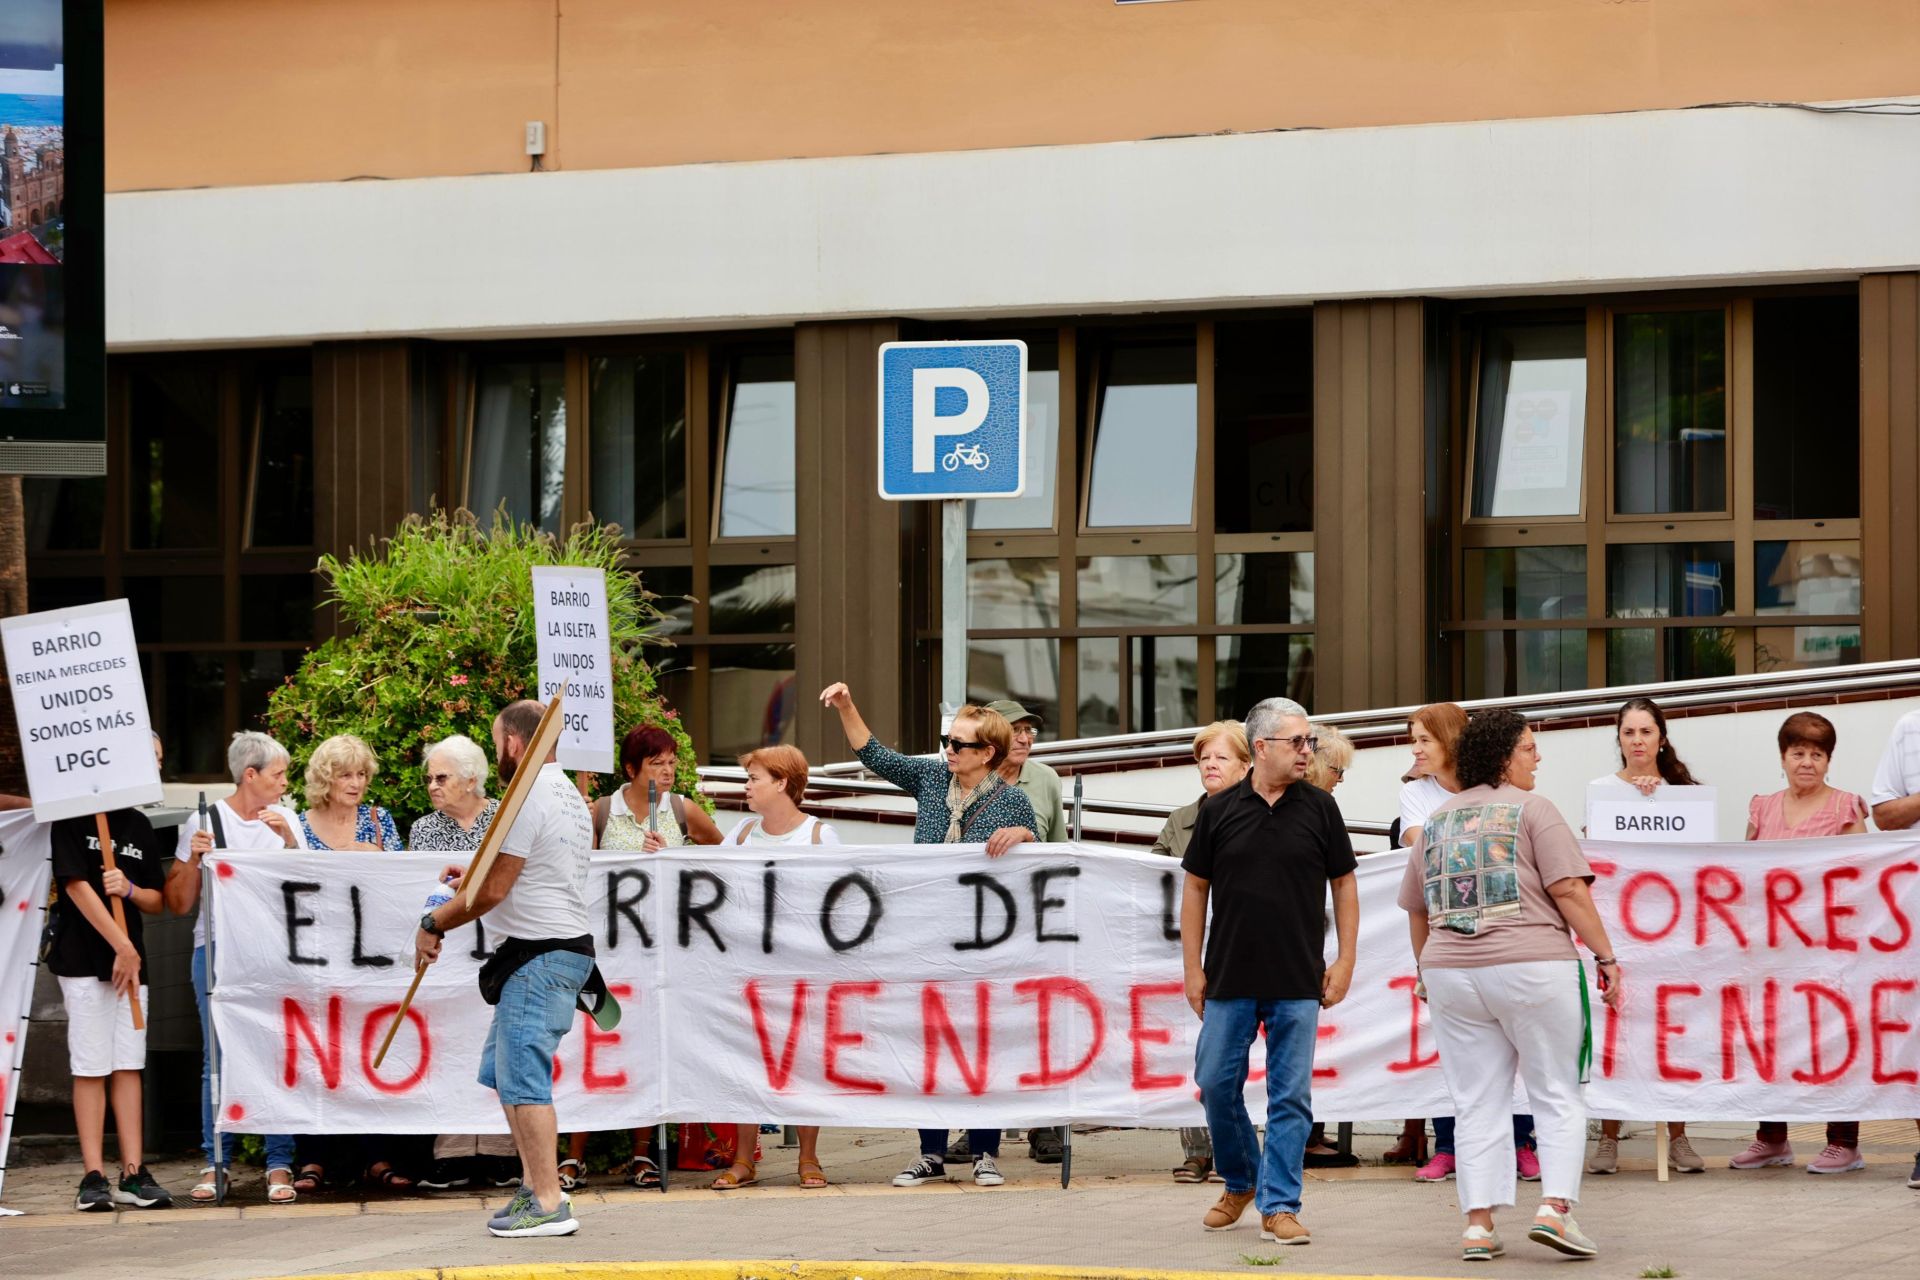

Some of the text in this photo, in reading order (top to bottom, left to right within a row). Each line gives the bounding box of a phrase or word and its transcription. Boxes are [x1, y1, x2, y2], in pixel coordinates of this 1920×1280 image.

[913, 368, 990, 473] P
[551, 591, 590, 608] BARRIO
[548, 621, 596, 639] LA ISLETA
[32, 631, 102, 656] BARRIO
[15, 657, 127, 685] REINA MERCEDES
[553, 653, 595, 670] UNIDOS
[40, 684, 114, 710] UNIDOS
[583, 681, 605, 699] MÁS
[30, 709, 136, 742] SOMOS MÁS
[564, 713, 589, 732] PGC
[55, 747, 111, 773] LPGC
[1615, 815, 1686, 832] BARRIO
[280, 880, 395, 968] EL
[952, 866, 1081, 951] DE
[282, 993, 432, 1095] NO
